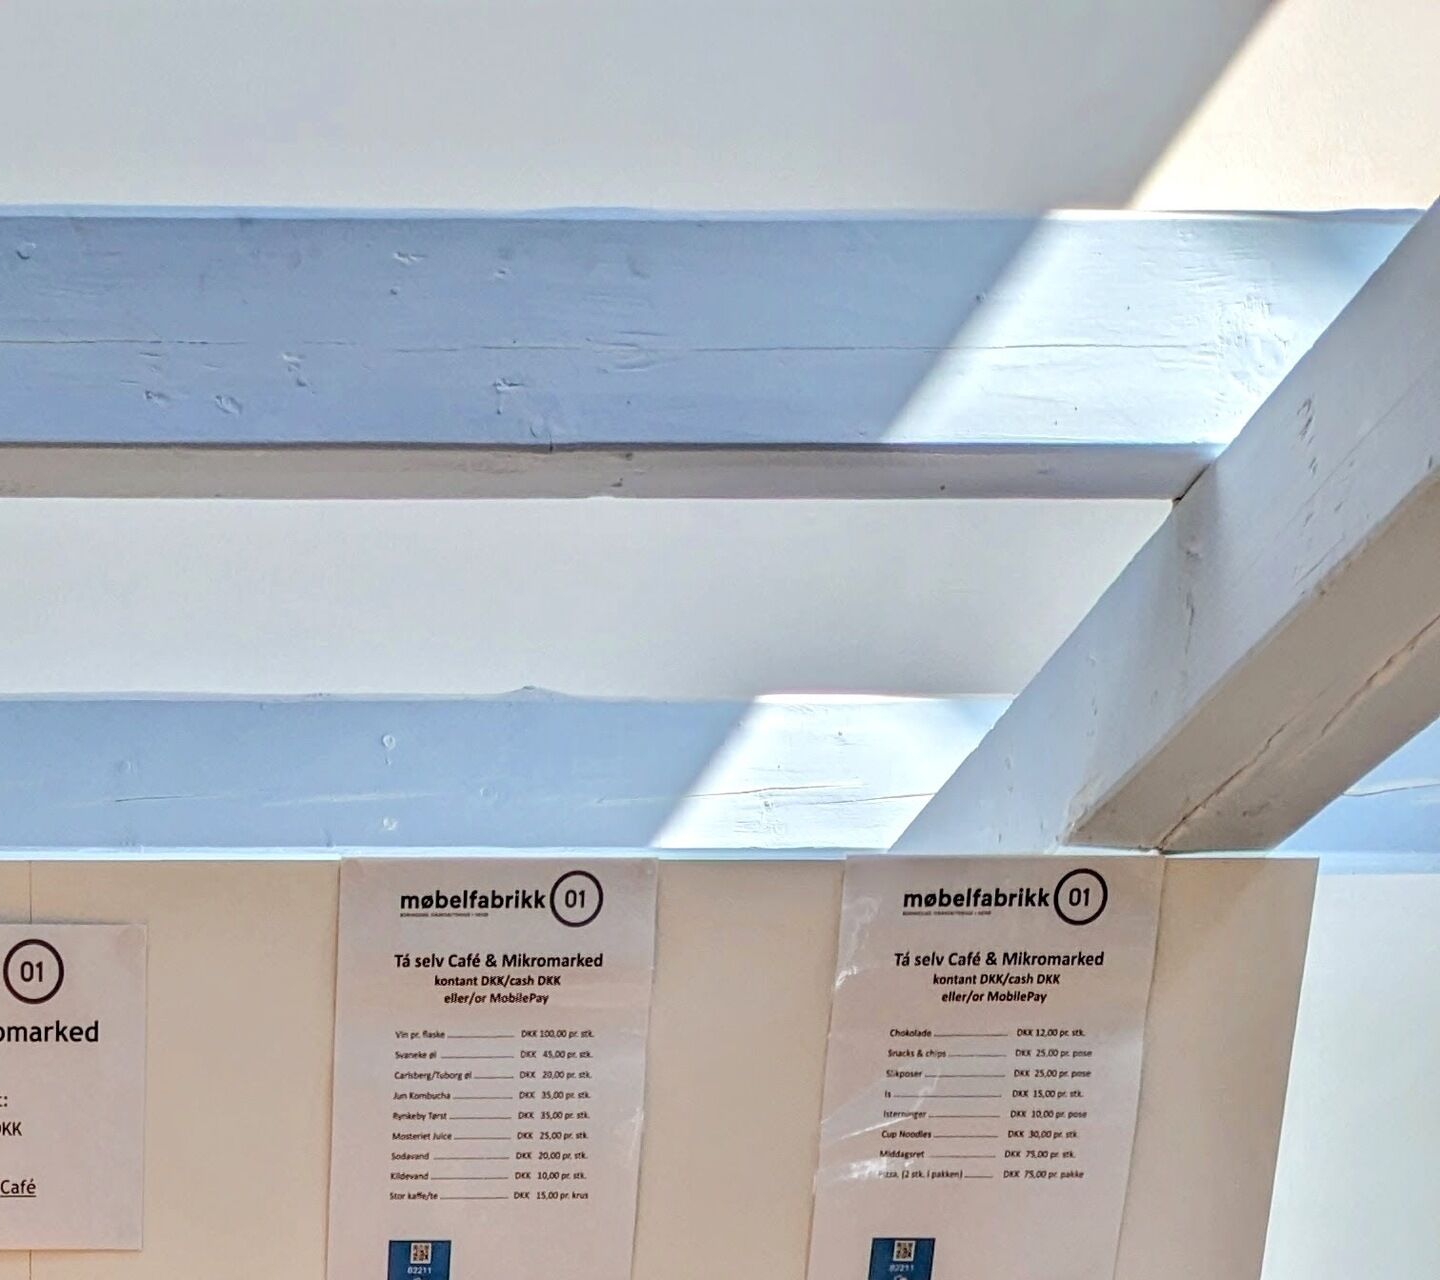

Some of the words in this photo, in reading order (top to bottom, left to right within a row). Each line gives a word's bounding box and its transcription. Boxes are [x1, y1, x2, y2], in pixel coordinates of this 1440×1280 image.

[400, 889, 545, 910] møbelfabrikk
[565, 889, 586, 908] 01
[903, 888, 1049, 908] møbelfabrikk
[1069, 887, 1091, 907] 01
[415, 954, 444, 968] selv
[448, 953, 481, 968] Café
[485, 954, 497, 967] &
[502, 953, 603, 968] Mikromarked
[914, 952, 944, 966] selv
[948, 951, 982, 966] Café
[986, 952, 998, 966] &
[1002, 951, 1104, 966] Mikromarked
[20, 960, 44, 982] 01
[434, 976, 478, 986] kontant
[481, 976, 535, 987] DKK/cash
[538, 976, 560, 986] DKK
[933, 974, 977, 985] kontant
[980, 974, 1034, 985] DKK/cash
[1037, 974, 1060, 985] DKK
[444, 993, 486, 1004] eller/or
[490, 993, 548, 1005] MobilePay
[942, 991, 984, 1003] eller/or
[987, 991, 1047, 1004] MobilePay
[0, 1179, 36, 1195] Café
